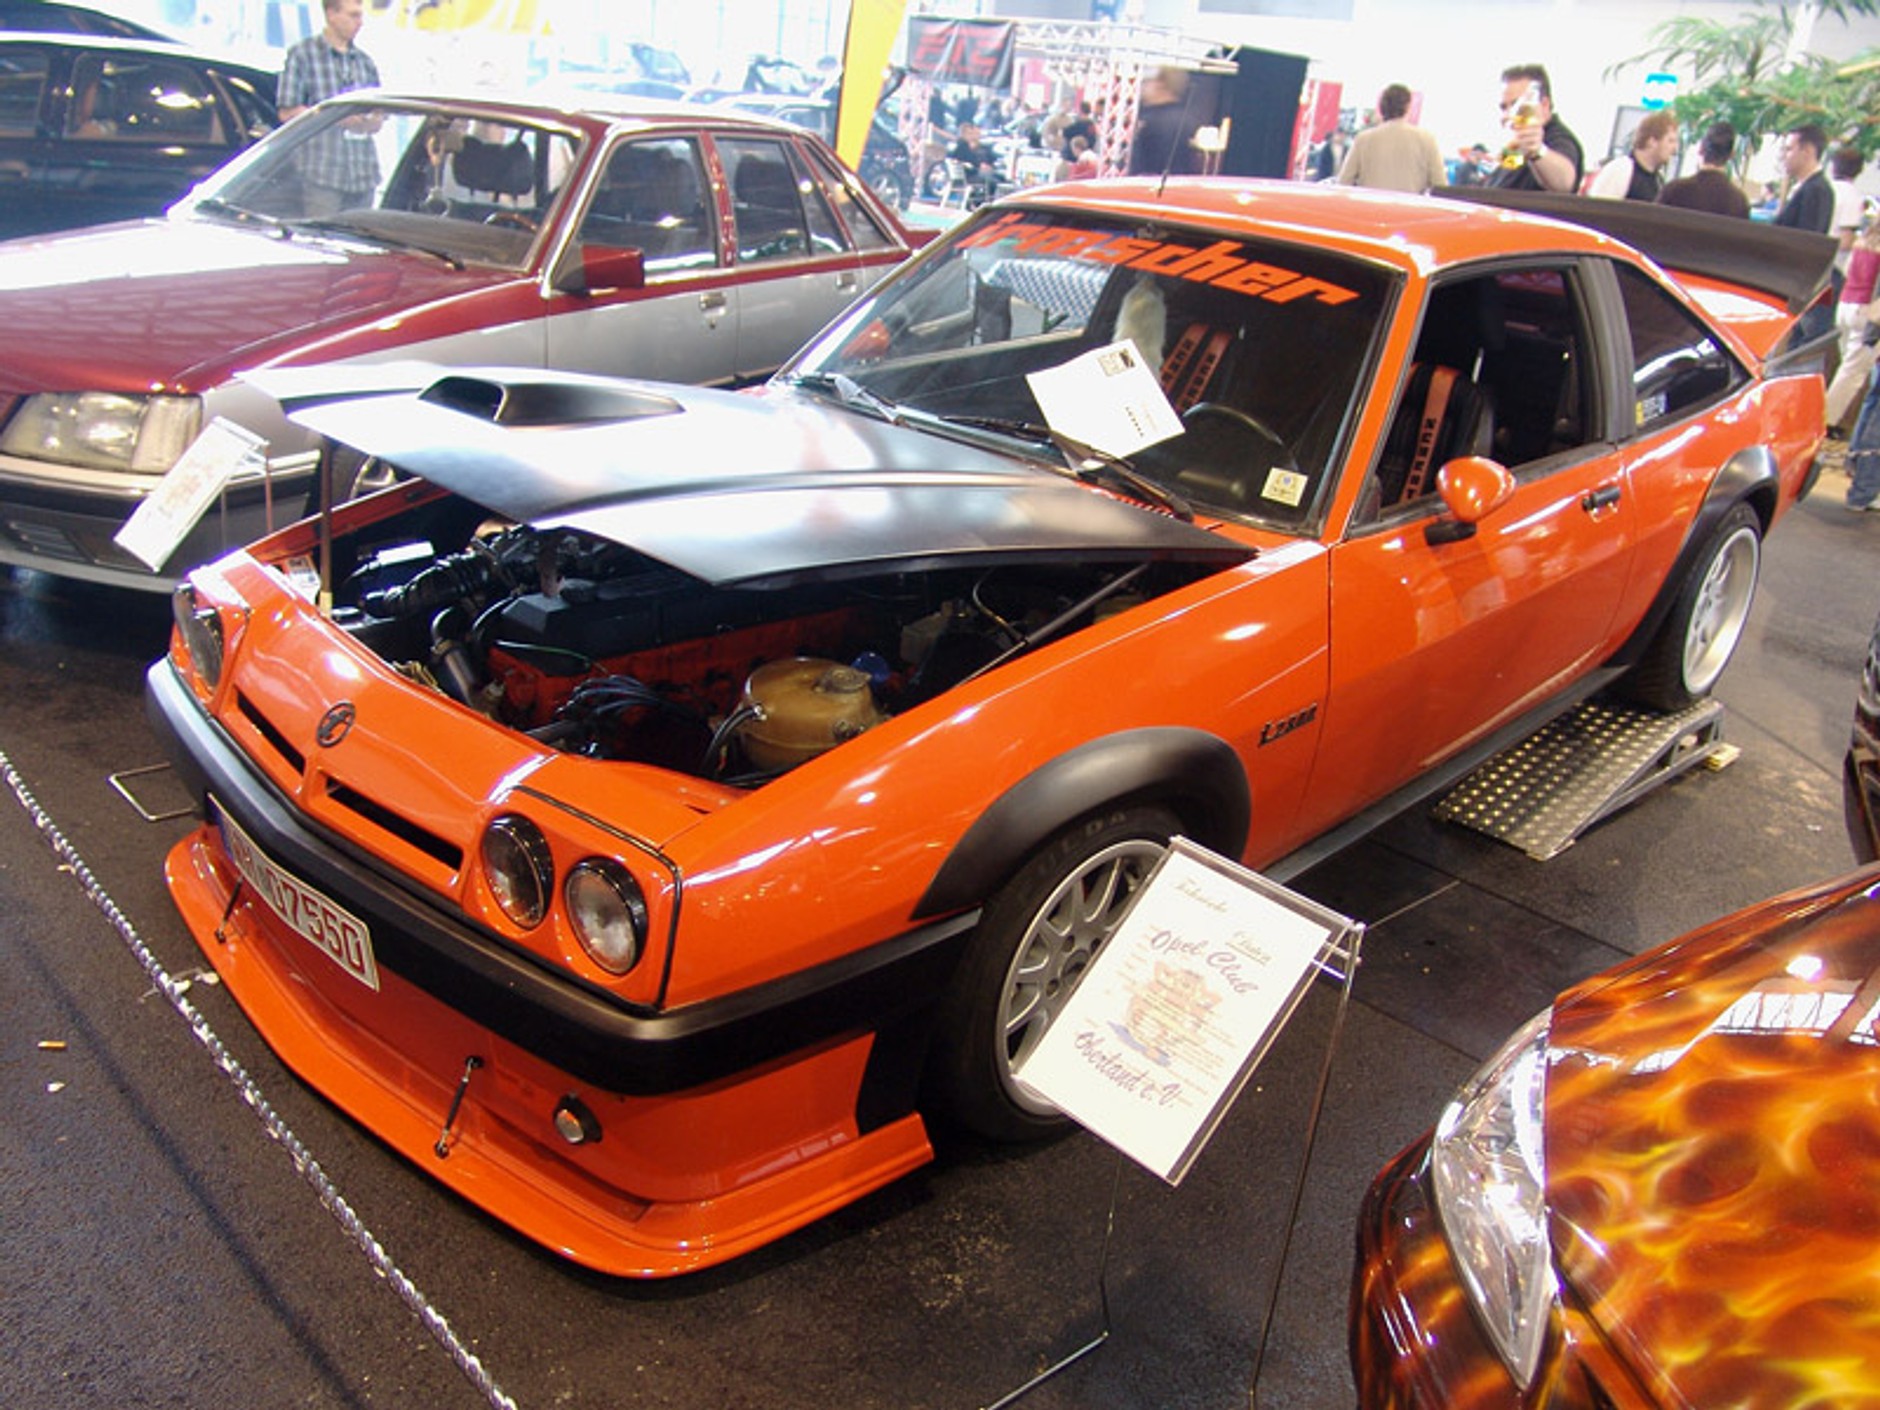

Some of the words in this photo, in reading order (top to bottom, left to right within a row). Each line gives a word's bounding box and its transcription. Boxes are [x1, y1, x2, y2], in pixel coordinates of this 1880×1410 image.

[954, 211, 1360, 307] irmscher
[1150, 930, 1209, 955] Opel
[1206, 951, 1259, 994] Club
